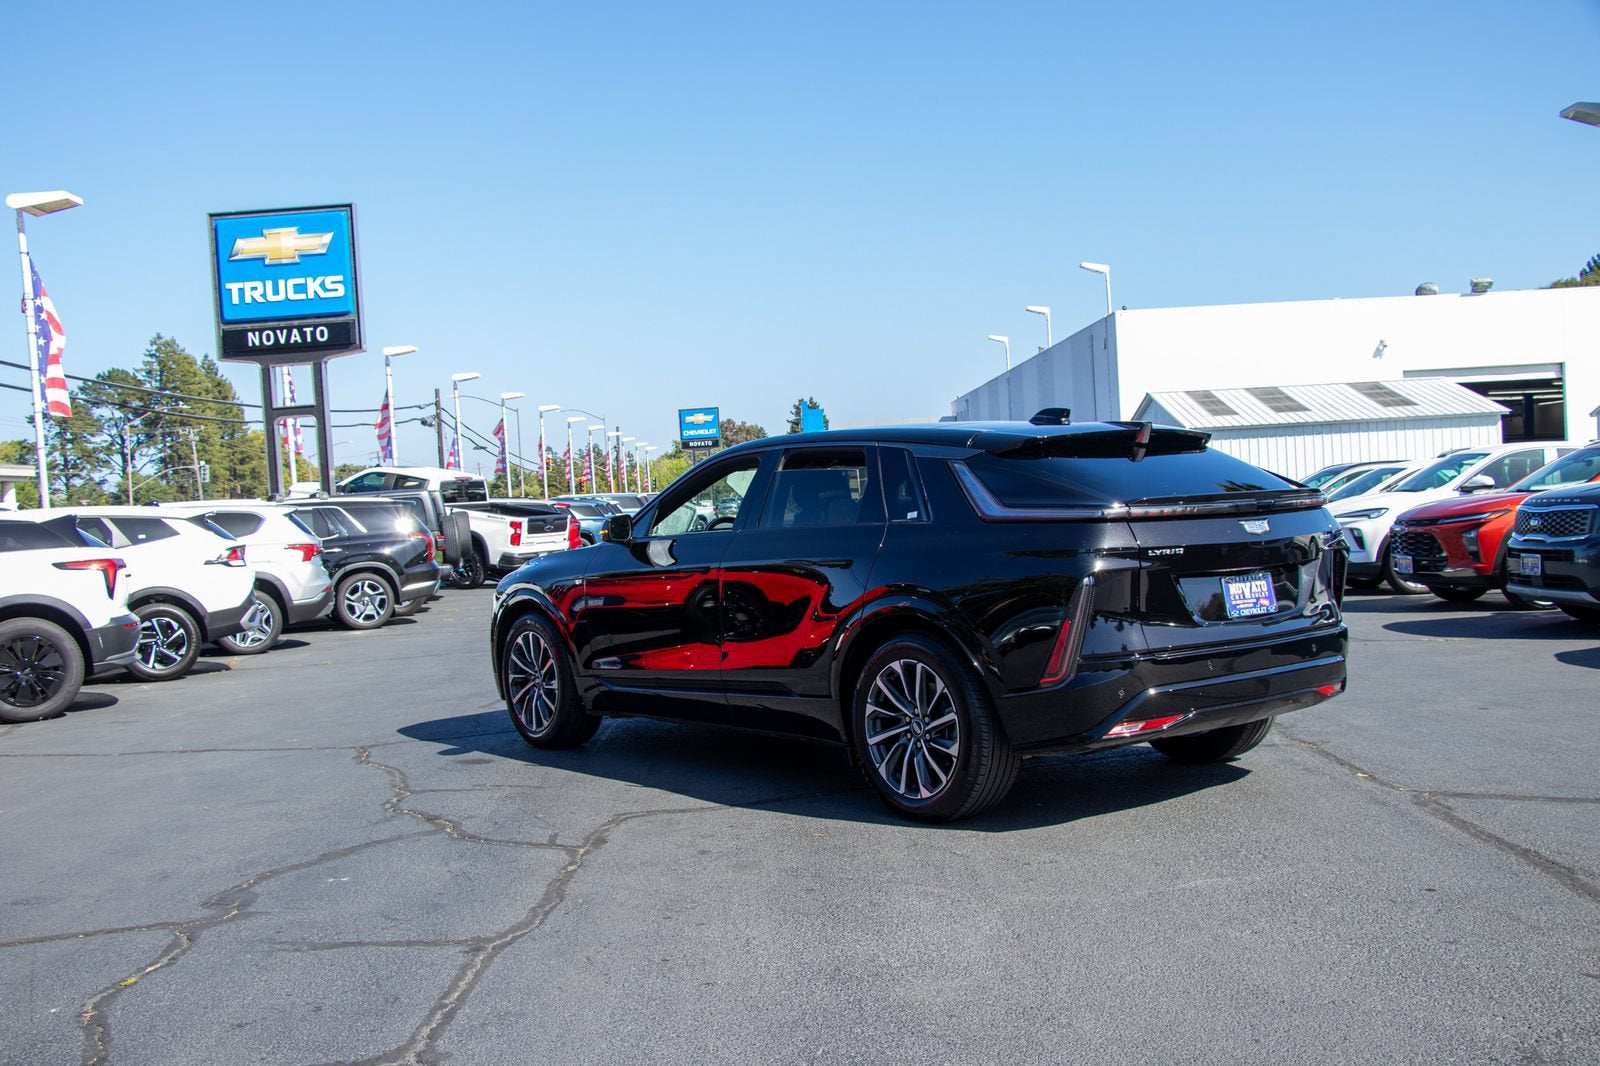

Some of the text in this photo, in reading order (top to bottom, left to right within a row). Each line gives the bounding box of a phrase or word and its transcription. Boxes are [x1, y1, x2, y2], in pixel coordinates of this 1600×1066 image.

[225, 275, 345, 305] TRUCKS
[247, 326, 329, 347] NOVATO
[1148, 548, 1184, 556] LYRIQ
[1229, 580, 1268, 596] NOVATO
